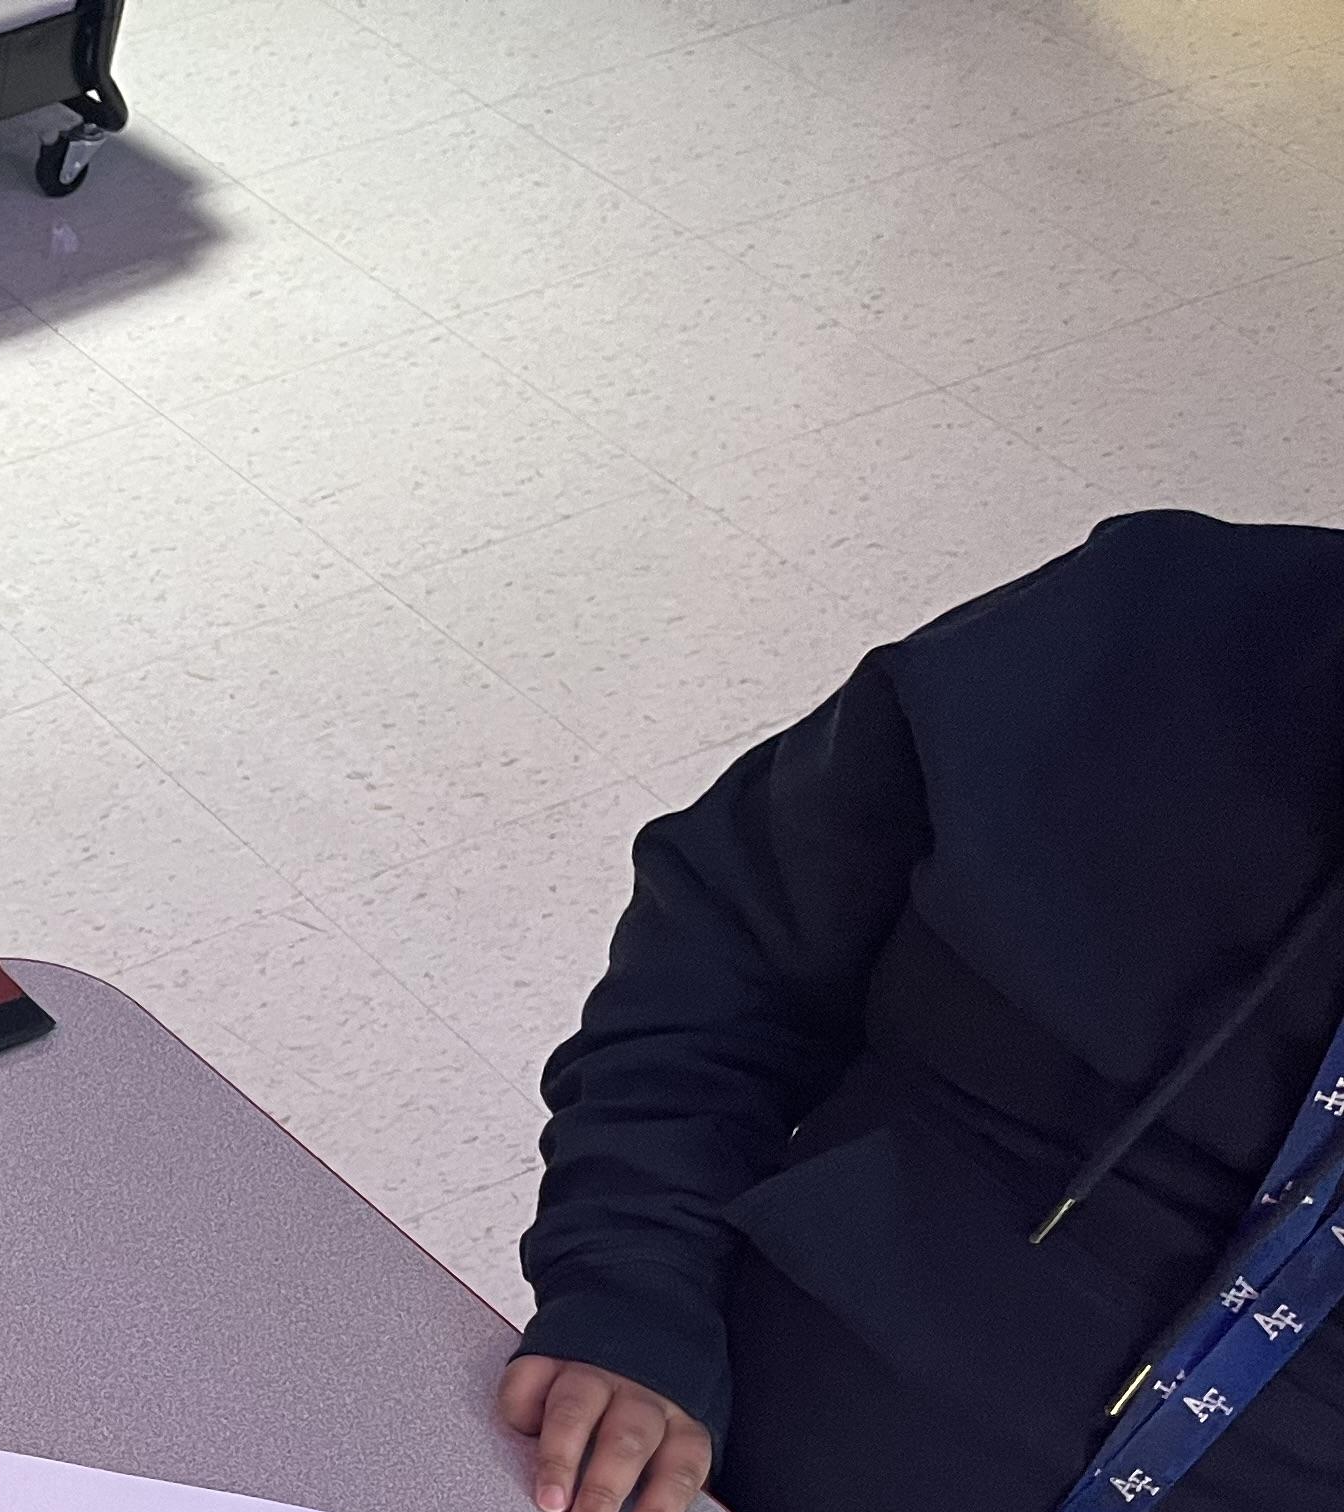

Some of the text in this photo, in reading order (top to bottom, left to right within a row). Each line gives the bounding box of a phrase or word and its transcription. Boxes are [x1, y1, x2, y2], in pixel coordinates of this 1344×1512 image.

[1253, 1303, 1304, 1341] AF
[1182, 1386, 1234, 1424] AF
[1109, 1468, 1161, 1503] AF
